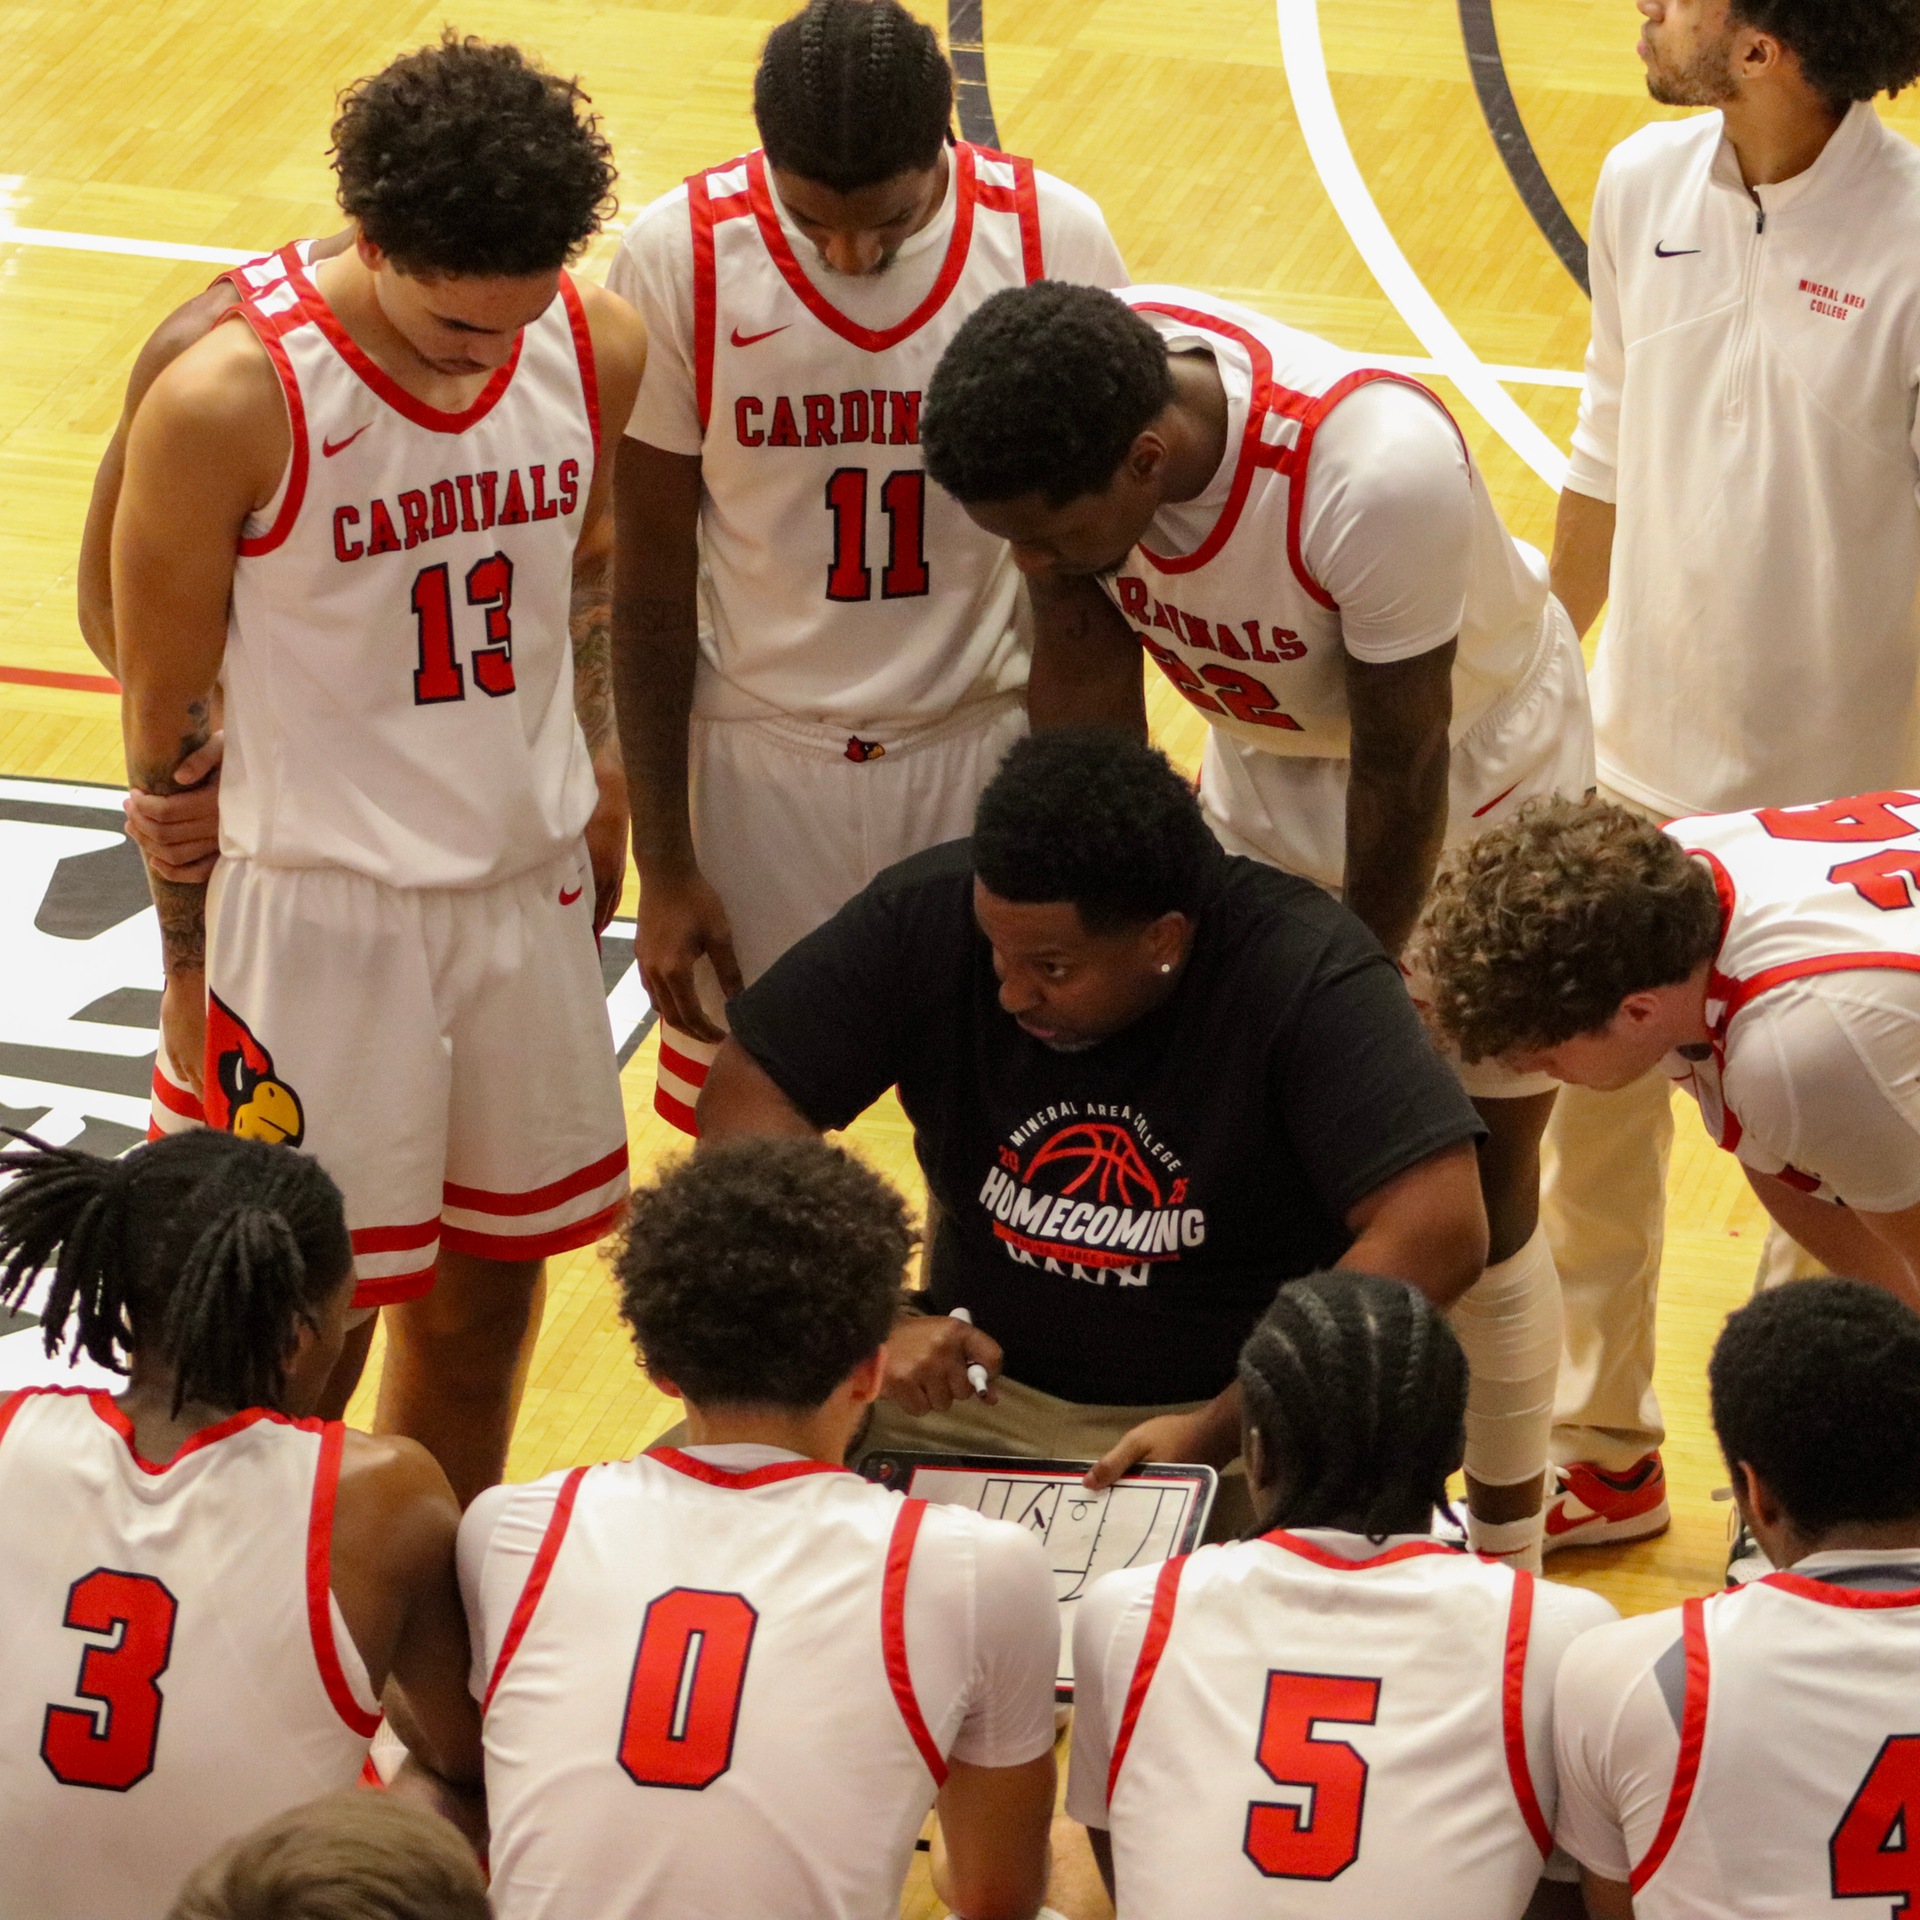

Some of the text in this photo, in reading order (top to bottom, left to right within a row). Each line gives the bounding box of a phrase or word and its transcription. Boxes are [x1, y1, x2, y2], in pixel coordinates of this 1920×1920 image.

[1799, 279, 1866, 309] MINERAL AREA
[1810, 299, 1848, 320] COLLEGE
[735, 389, 922, 447] CARDIN
[825, 467, 929, 602] 11
[411, 551, 516, 705] 13
[999, 1144, 1020, 1174] 20
[1009, 1101, 1182, 1172] MINERAL AREA COLLEGE
[979, 1165, 1206, 1253] HOMECOMING
[1168, 1176, 1190, 1205] 25
[40, 1566, 179, 1792] 3
[616, 1585, 759, 1791] 0
[1242, 1668, 1382, 1882] 5
